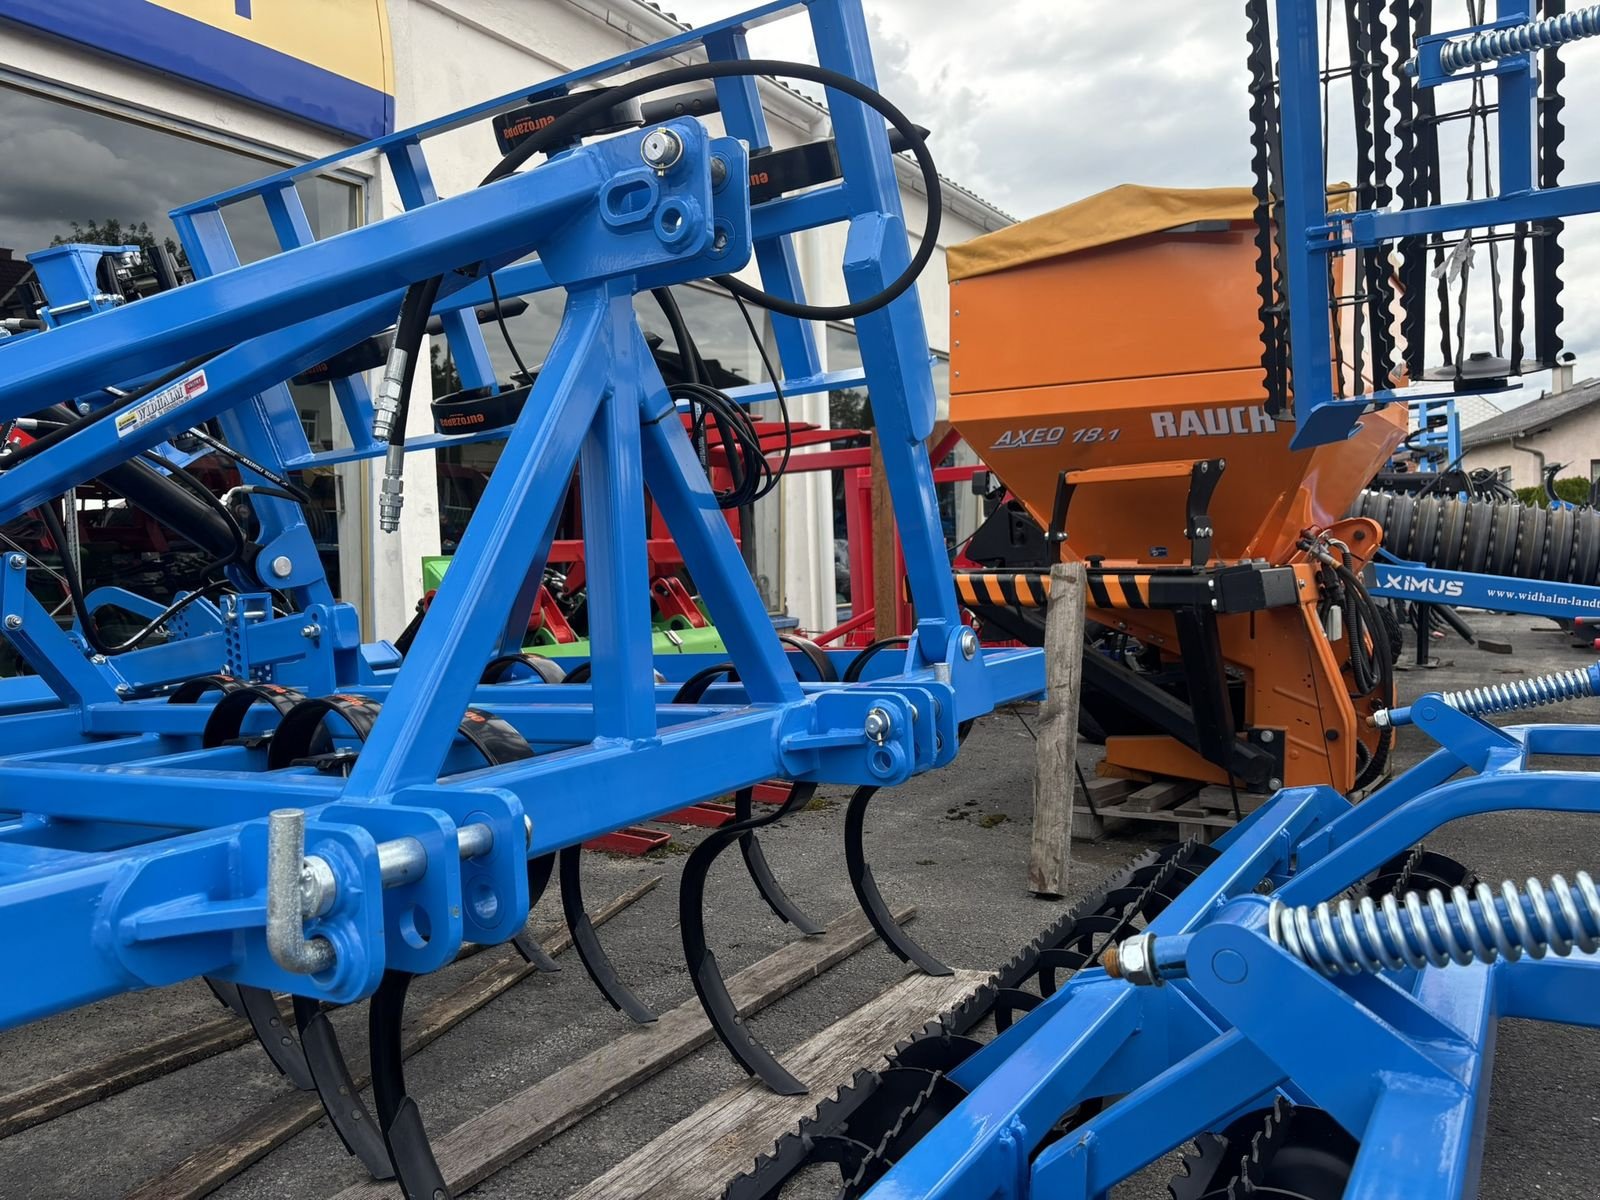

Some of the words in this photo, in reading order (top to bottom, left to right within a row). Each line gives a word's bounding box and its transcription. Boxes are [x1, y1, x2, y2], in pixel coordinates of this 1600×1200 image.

[503, 115, 556, 139] eurozappa
[138, 386, 184, 420] WIDHALM
[1150, 405, 1277, 438] RAUCH
[991, 426, 1065, 448] AXEO
[1071, 427, 1121, 443] 18.1
[1376, 573, 1464, 597] XIMUS
